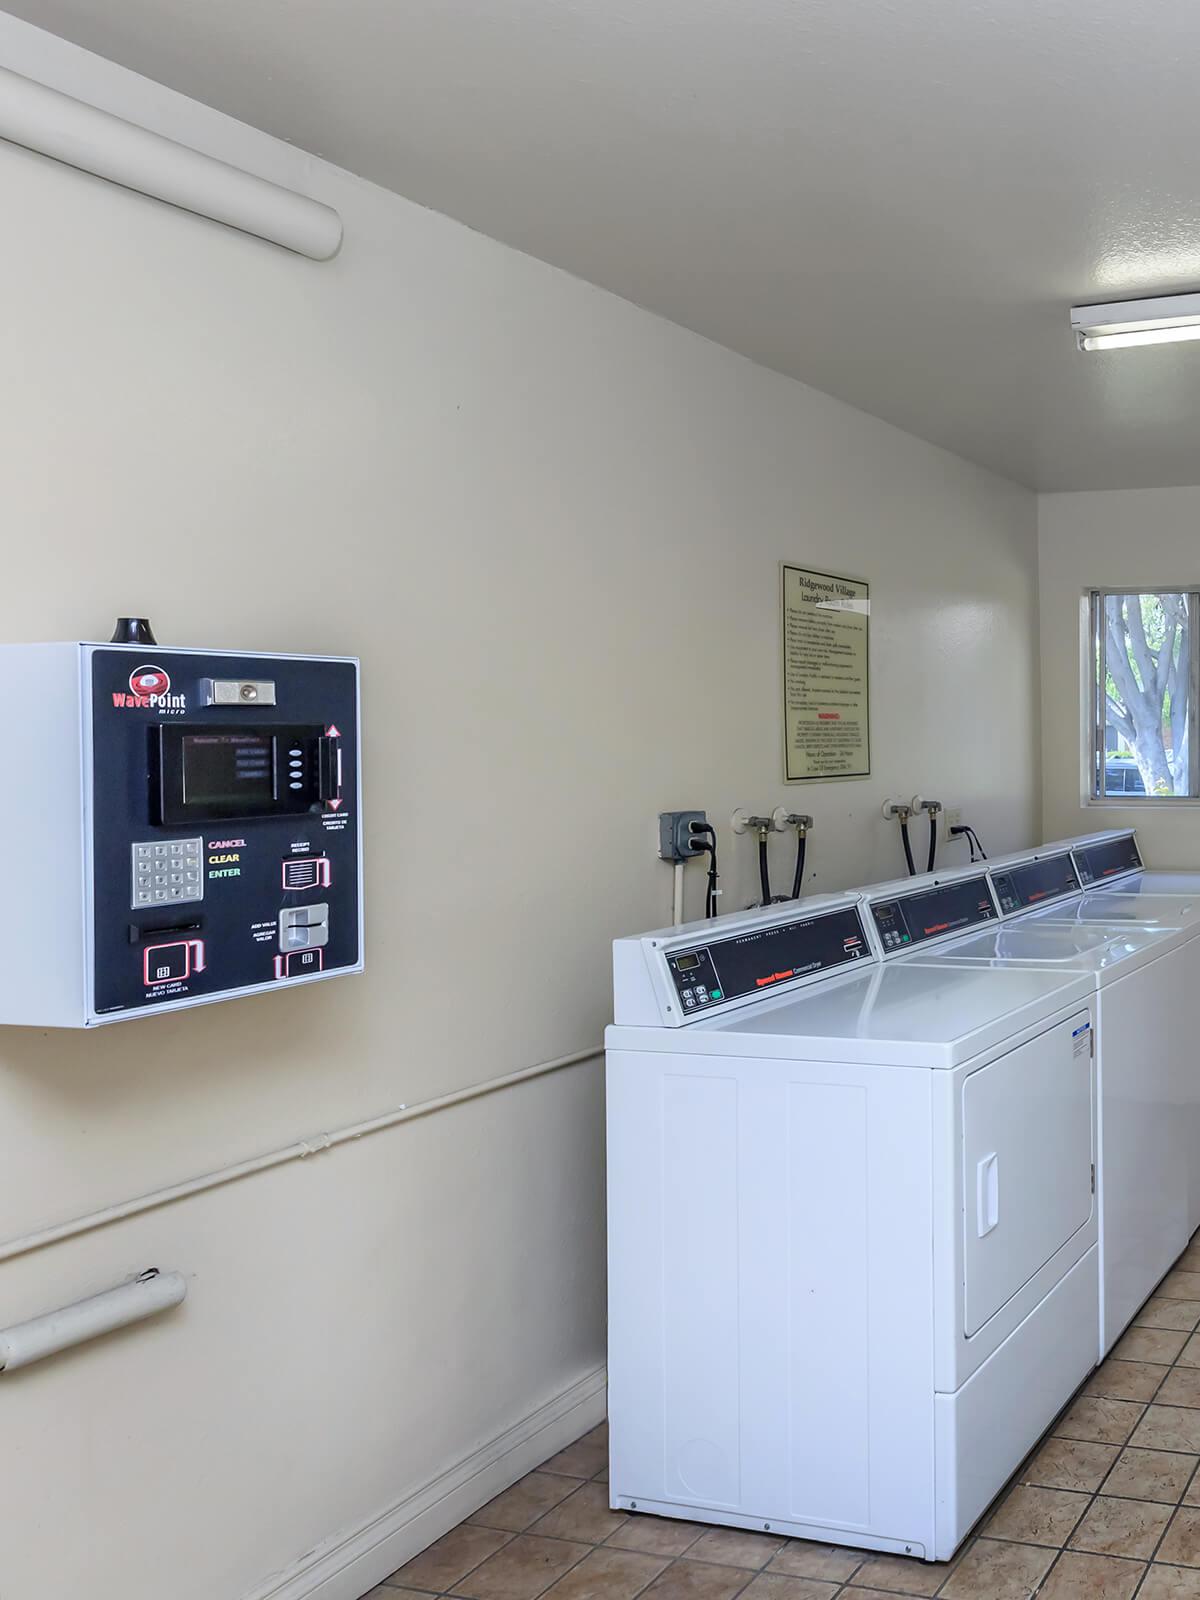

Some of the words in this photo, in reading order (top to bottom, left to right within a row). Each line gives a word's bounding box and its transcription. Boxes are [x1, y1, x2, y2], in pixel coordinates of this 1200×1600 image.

[799, 576, 834, 592] Ridgewood
[835, 583, 856, 599] Village
[801, 591, 823, 604] Laundry
[112, 692, 186, 708] WavePoint
[208, 839, 247, 849] CANCEL
[209, 854, 240, 864] CLEAR
[208, 868, 241, 878] ENTER
[152, 983, 166, 992] NEW
[166, 981, 182, 989] CARD
[145, 989, 166, 999] NUEVO
